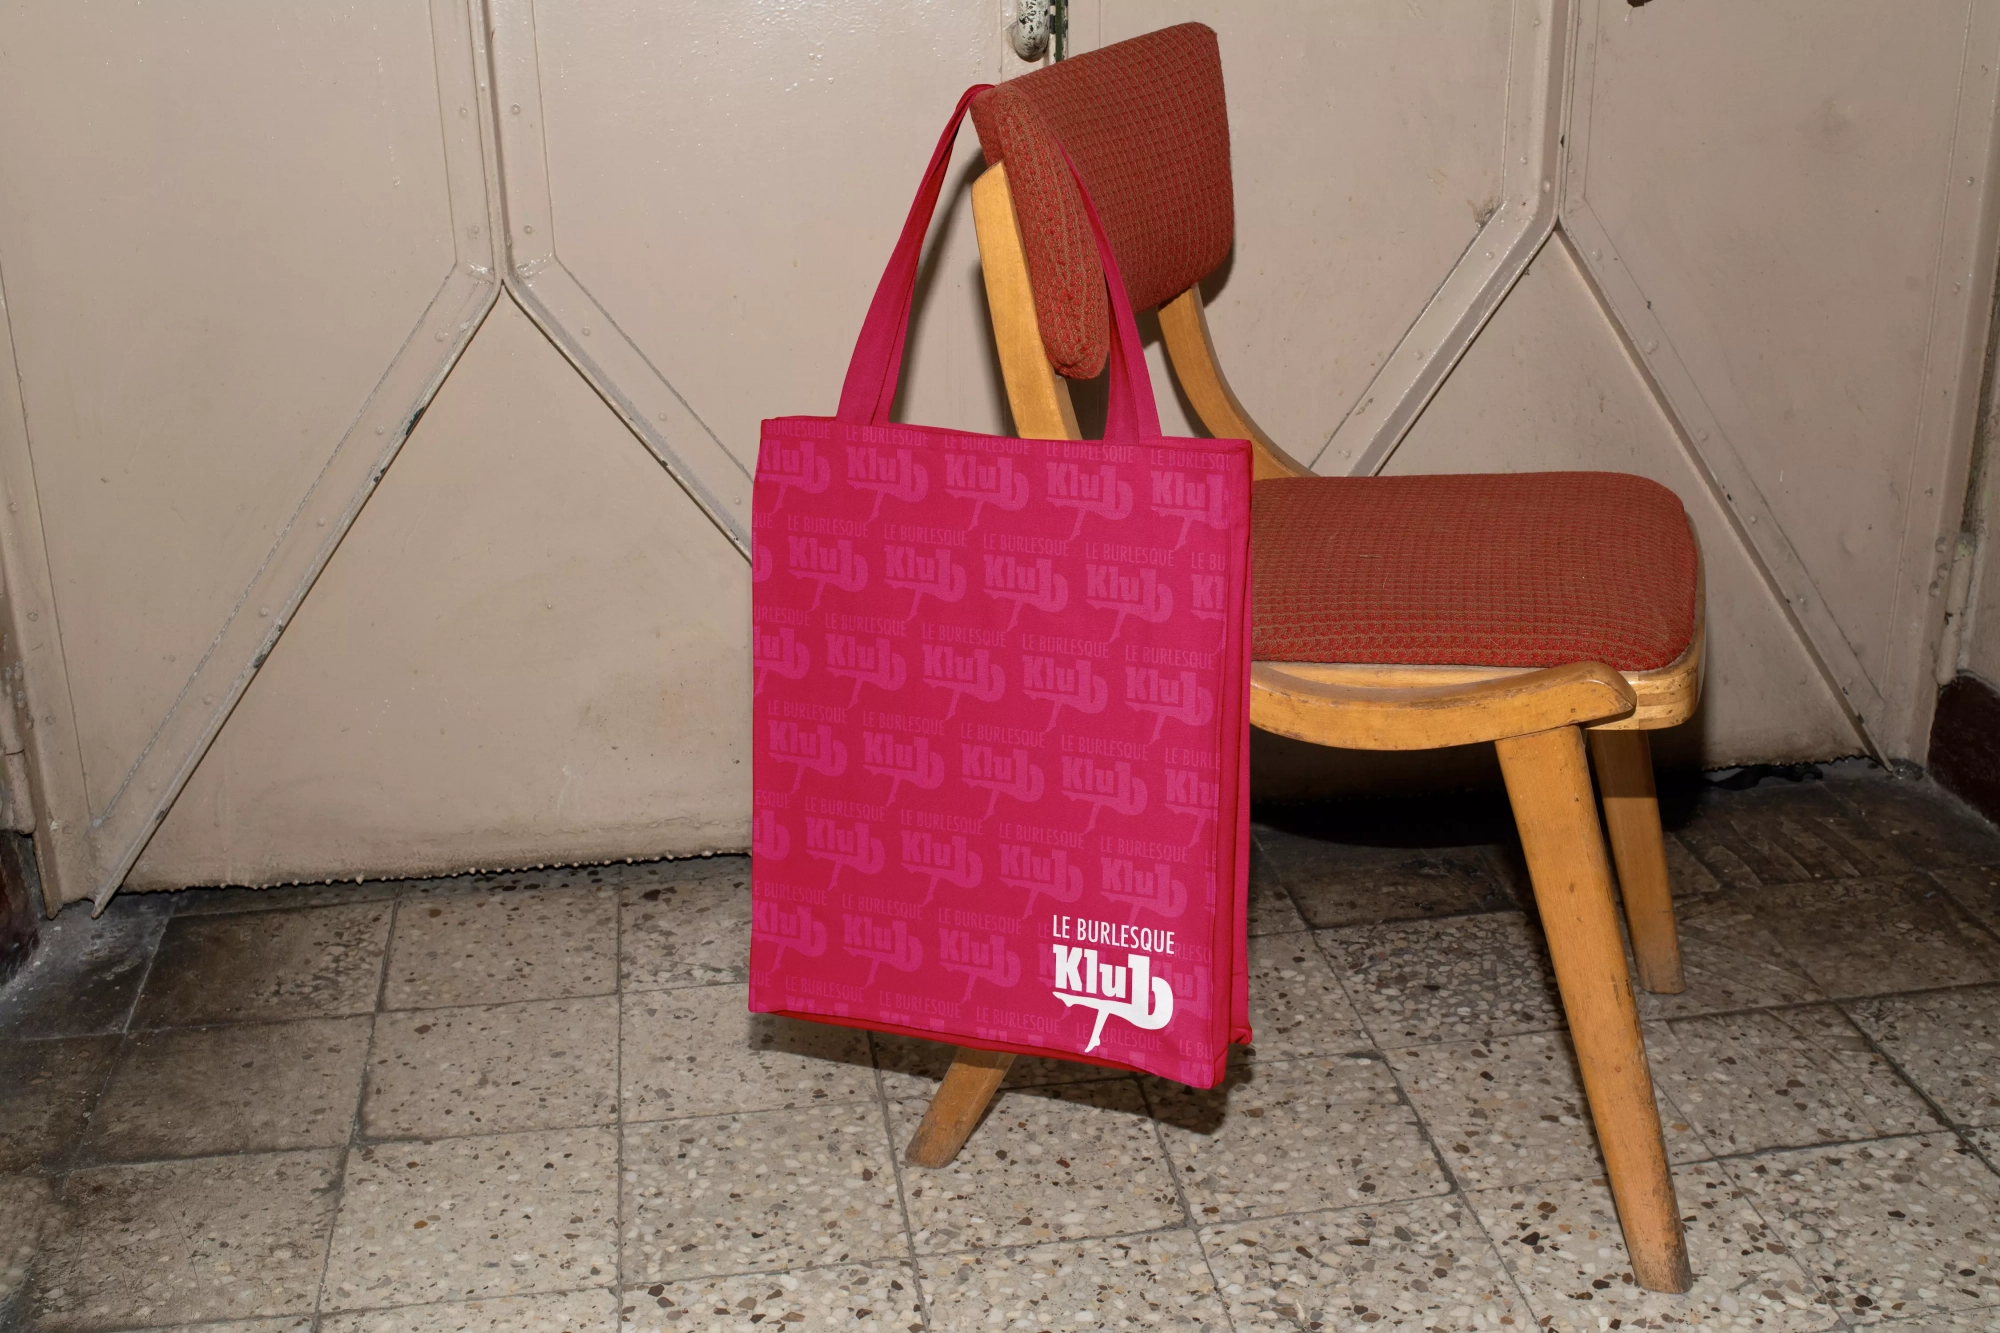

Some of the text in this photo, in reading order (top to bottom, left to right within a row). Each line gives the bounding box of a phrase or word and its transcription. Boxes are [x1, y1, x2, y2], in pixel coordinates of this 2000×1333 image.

[846, 425, 928, 447] LE BURLESQUE
[1151, 450, 1163, 465] LE
[847, 447, 929, 502] Klub
[945, 454, 1029, 511] Klub
[1047, 462, 1133, 520] Klub
[788, 515, 799, 531] LE
[804, 516, 868, 538] BURLESQUE
[884, 523, 967, 547] LE BURLESQUE
[984, 533, 1069, 557] LE BURLESQUE
[1086, 542, 1174, 566] LE BURLESQUE
[788, 536, 868, 592] Klub
[884, 545, 967, 602] Klub
[983, 554, 1068, 612] Klub
[1086, 563, 1173, 623] Klub
[754, 605, 810, 626] URLESQUE
[825, 613, 906, 636] LE BURLESQUE
[923, 623, 1006, 648] LE BURLESQUE
[1022, 634, 1109, 659] LE BURLESQUE
[825, 633, 906, 690] Klub
[1125, 645, 1214, 670] LE BURLESQUE
[922, 644, 1005, 702] Klub
[1022, 655, 1107, 714] Klub
[1125, 666, 1213, 726] Klub
[768, 700, 848, 724] LE BURLESQUE
[863, 711, 945, 735] LE BURLESQUE
[768, 720, 847, 776] Klub
[961, 723, 1045, 748] LE BURLESQUE
[1062, 735, 1149, 760] LE BURLESQUE
[863, 731, 944, 789] Klub
[1166, 748, 1178, 763] LE
[961, 743, 1044, 802] Klub
[1062, 756, 1147, 815] Klub
[805, 796, 885, 822] LE BURLESQUE
[901, 809, 983, 835] LE BURLESQUE
[805, 816, 885, 874] Klub
[999, 822, 1084, 849] LE BURLESQUE
[901, 830, 983, 888] Klub
[1101, 837, 1187, 863] LE BURLESQUE
[1000, 844, 1083, 902] Klub
[764, 882, 827, 905] BURLESQUE
[1101, 857, 1187, 918] Klub
[843, 894, 923, 920] LE BURLESQUE
[938, 908, 1021, 935] LE BURLESQUE
[1053, 914, 1175, 954] LE BURLESQUE
[843, 914, 922, 972] Klub
[939, 927, 1021, 988] Klub
[786, 975, 796, 991] LE
[802, 978, 864, 1002] BURLESQUE
[1053, 944, 1174, 1030] Klub
[880, 990, 961, 1018] LE BURLESQUE
[994, 1007, 1060, 1035] BURLESQUE
[1102, 1026, 1162, 1051] URLESQUE
